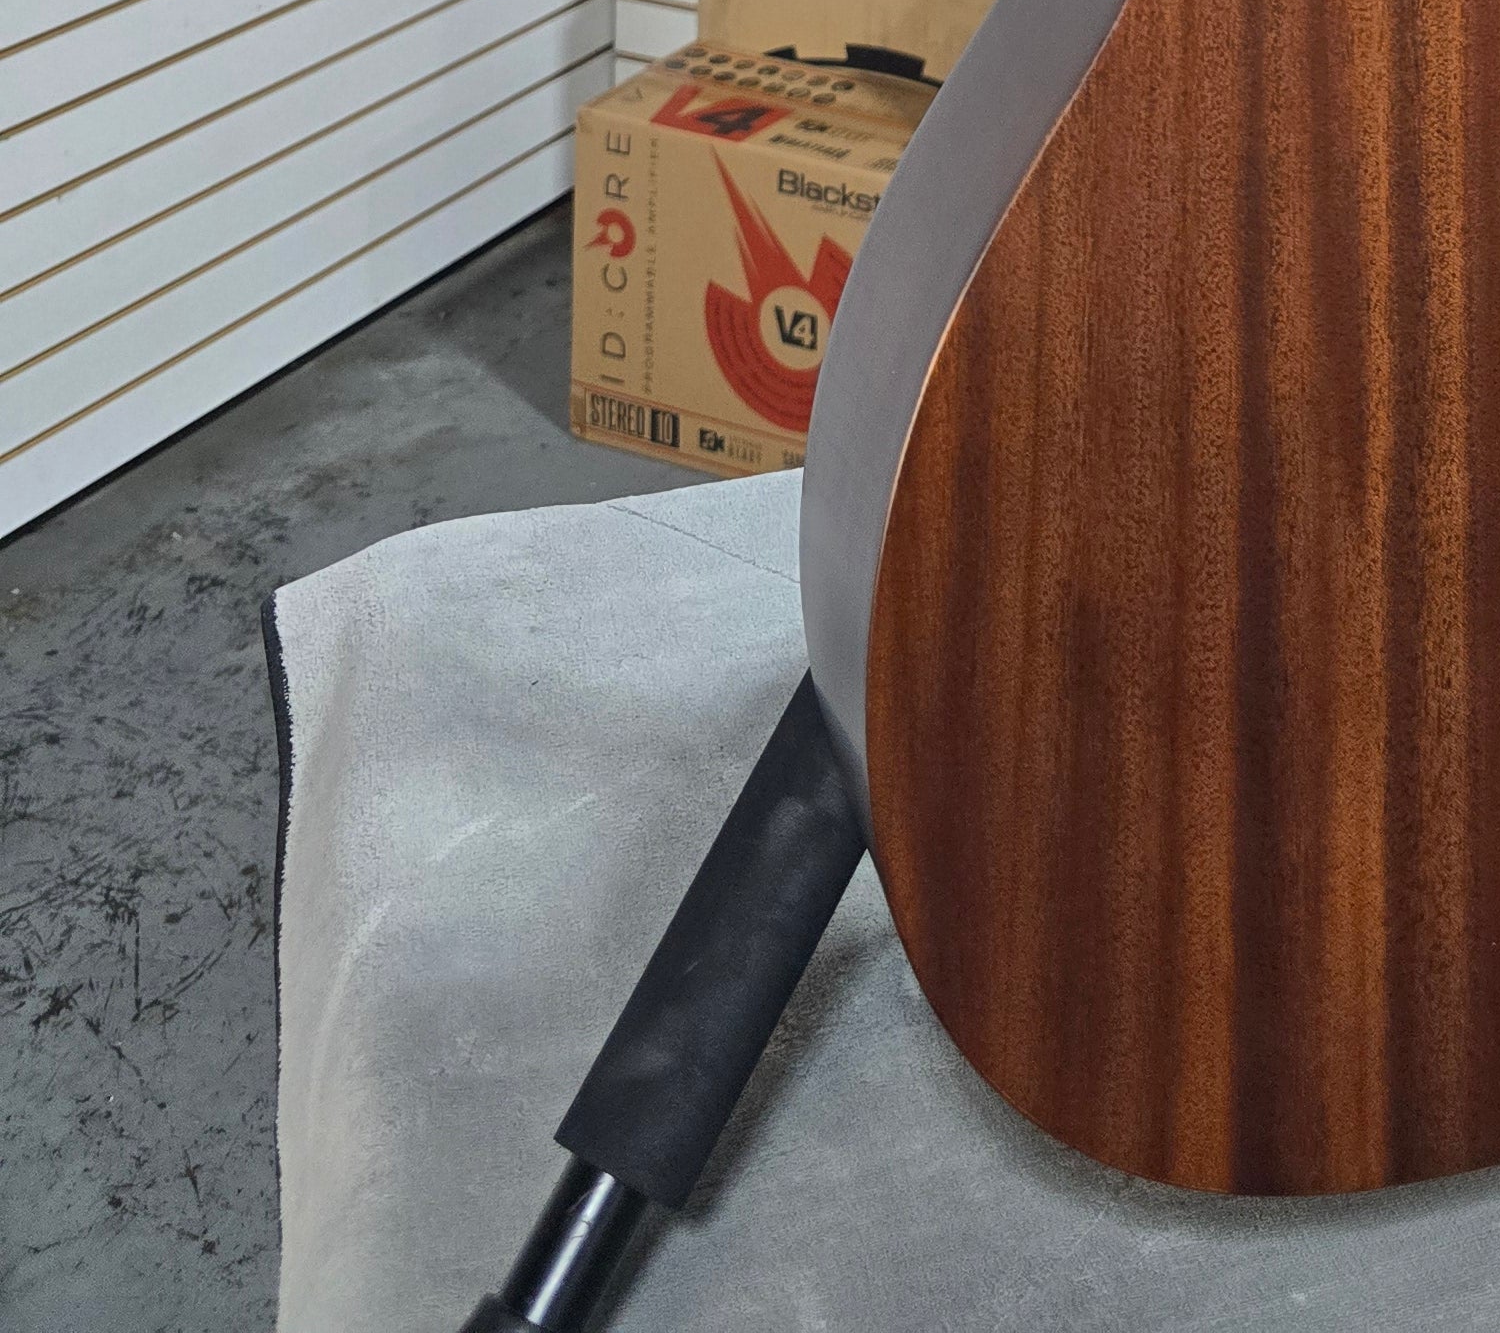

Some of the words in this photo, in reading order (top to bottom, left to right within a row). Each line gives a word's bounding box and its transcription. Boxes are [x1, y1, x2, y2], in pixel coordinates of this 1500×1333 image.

[777, 167, 882, 213] Blackst
[589, 392, 646, 437] STEREO
[657, 408, 675, 445] 10
